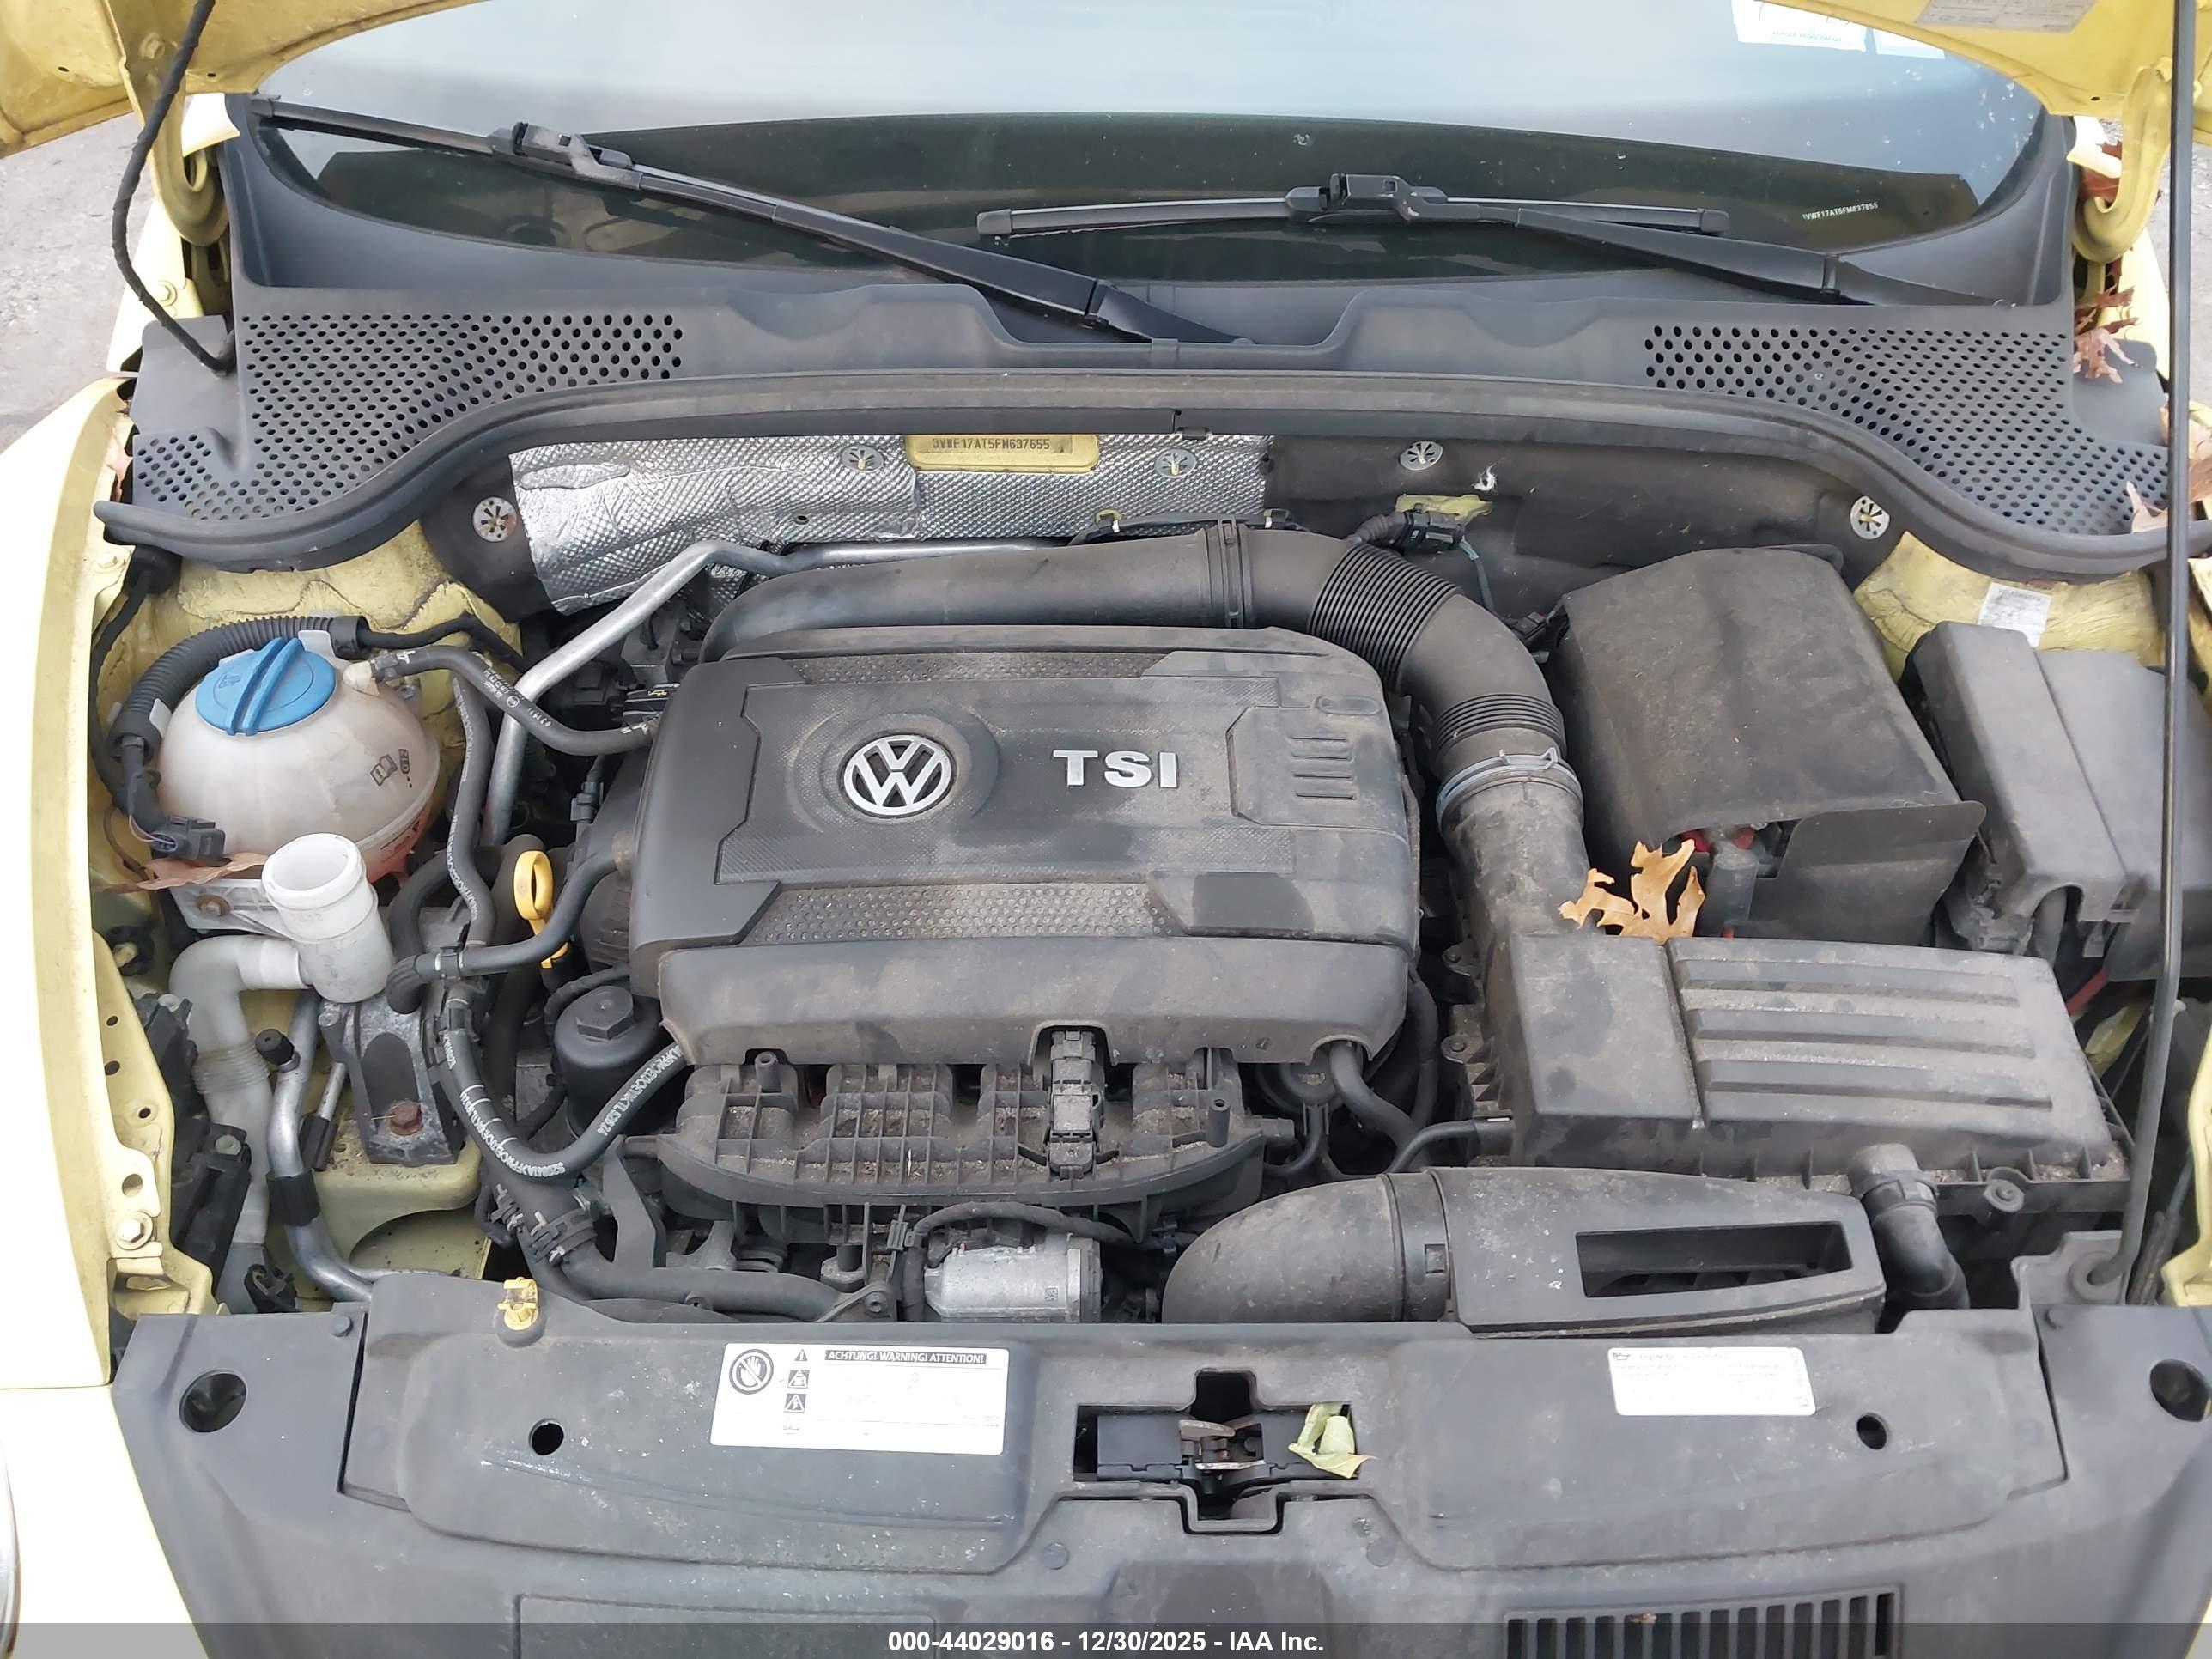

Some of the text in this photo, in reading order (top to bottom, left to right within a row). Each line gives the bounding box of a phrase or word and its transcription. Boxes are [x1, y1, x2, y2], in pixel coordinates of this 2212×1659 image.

[1053, 750, 1179, 788] TSI
[828, 1351, 985, 1364] ACHTUNG! WARNING! ATTENTION!
